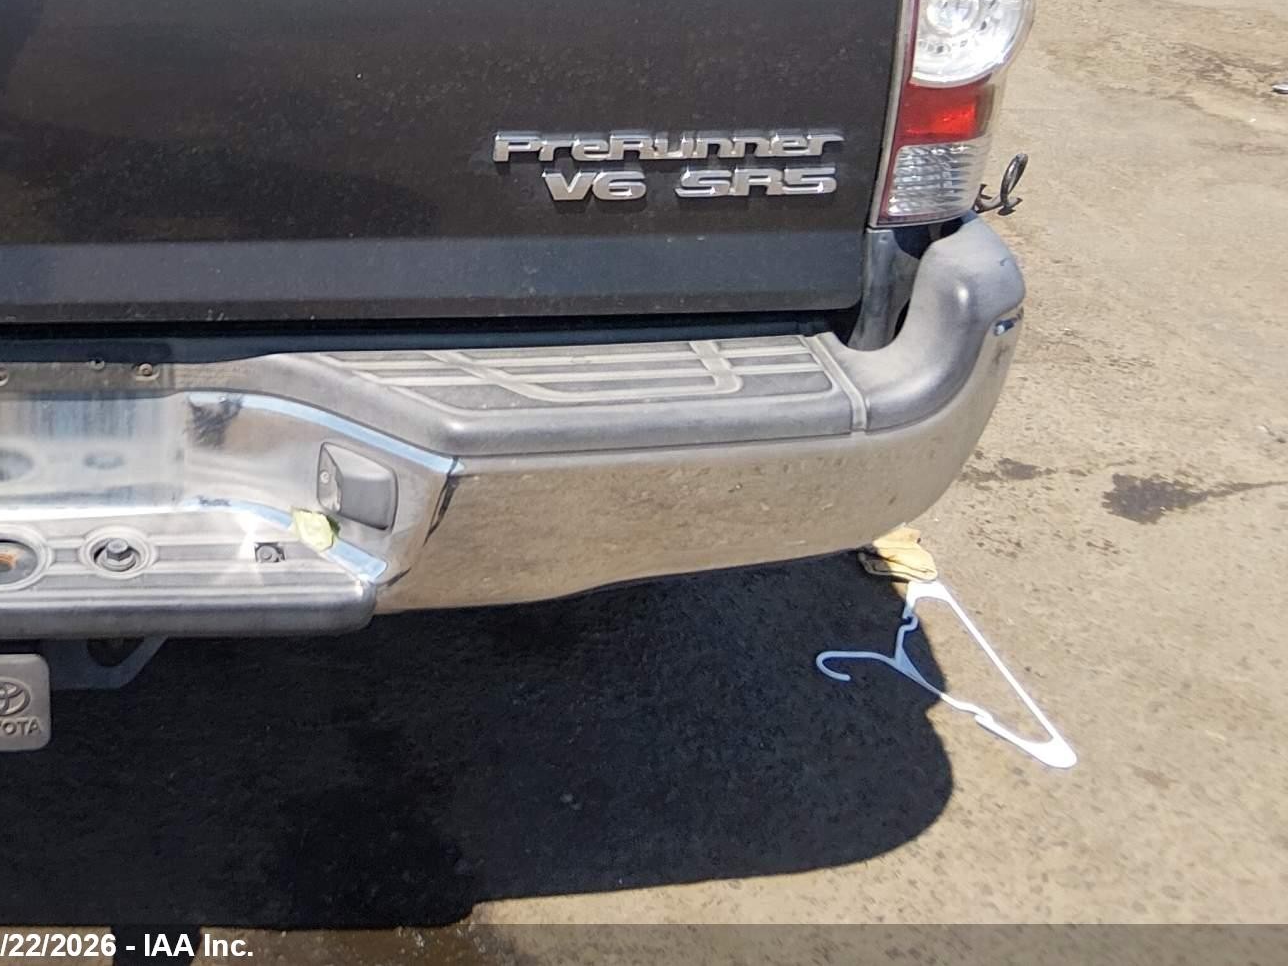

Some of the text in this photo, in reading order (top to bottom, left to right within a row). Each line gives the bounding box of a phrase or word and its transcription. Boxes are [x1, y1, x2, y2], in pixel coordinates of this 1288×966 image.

[492, 132, 845, 162] PreRunner
[542, 166, 837, 201] V6 SR5
